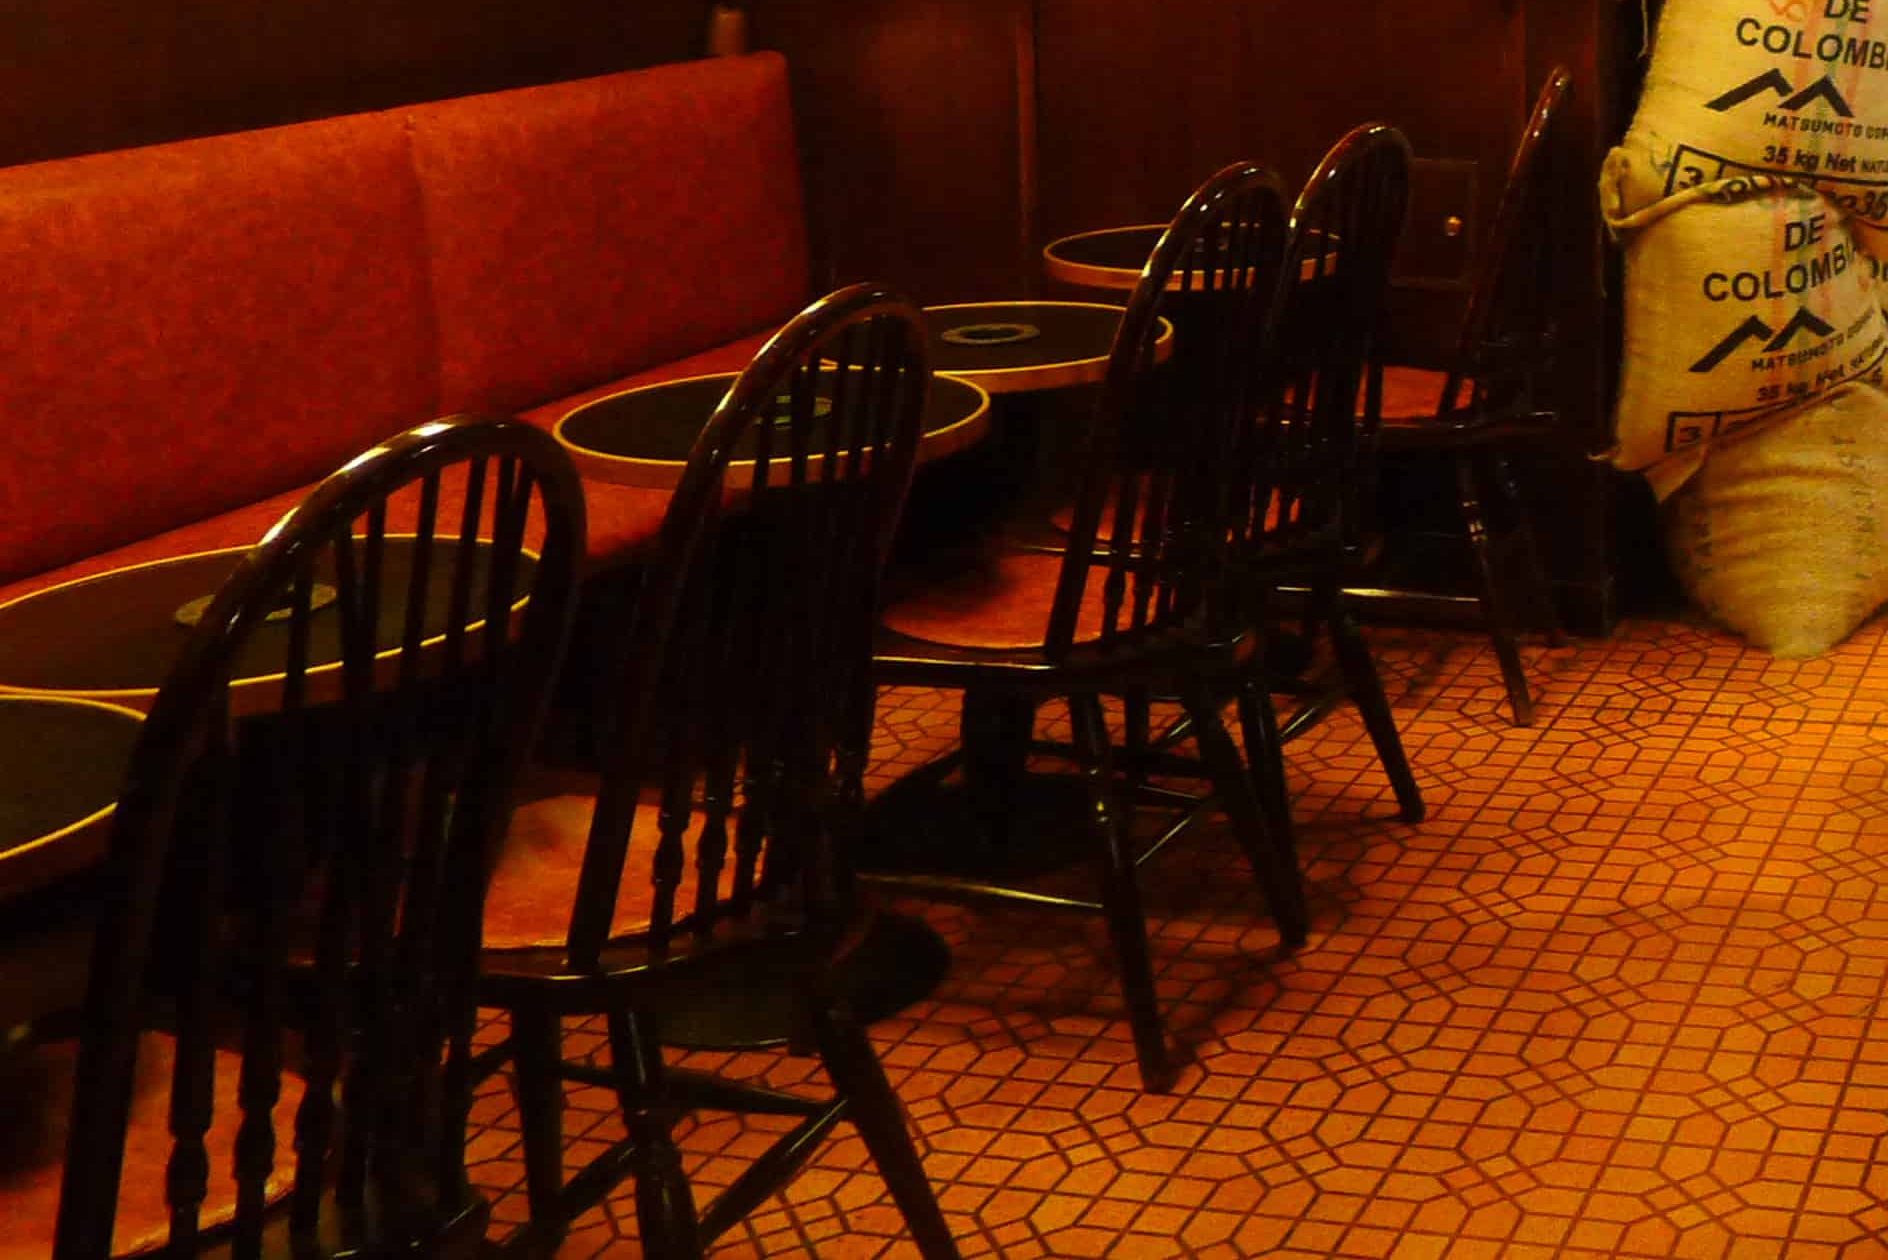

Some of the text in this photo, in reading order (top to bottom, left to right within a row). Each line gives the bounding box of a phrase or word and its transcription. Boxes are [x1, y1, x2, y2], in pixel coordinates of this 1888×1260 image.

[1763, 111, 1863, 138] MATSUMOTO
[1762, 145, 1788, 164] 35
[1793, 148, 1820, 171] kg
[1824, 152, 1857, 173] Net
[1785, 213, 1826, 252] DE
